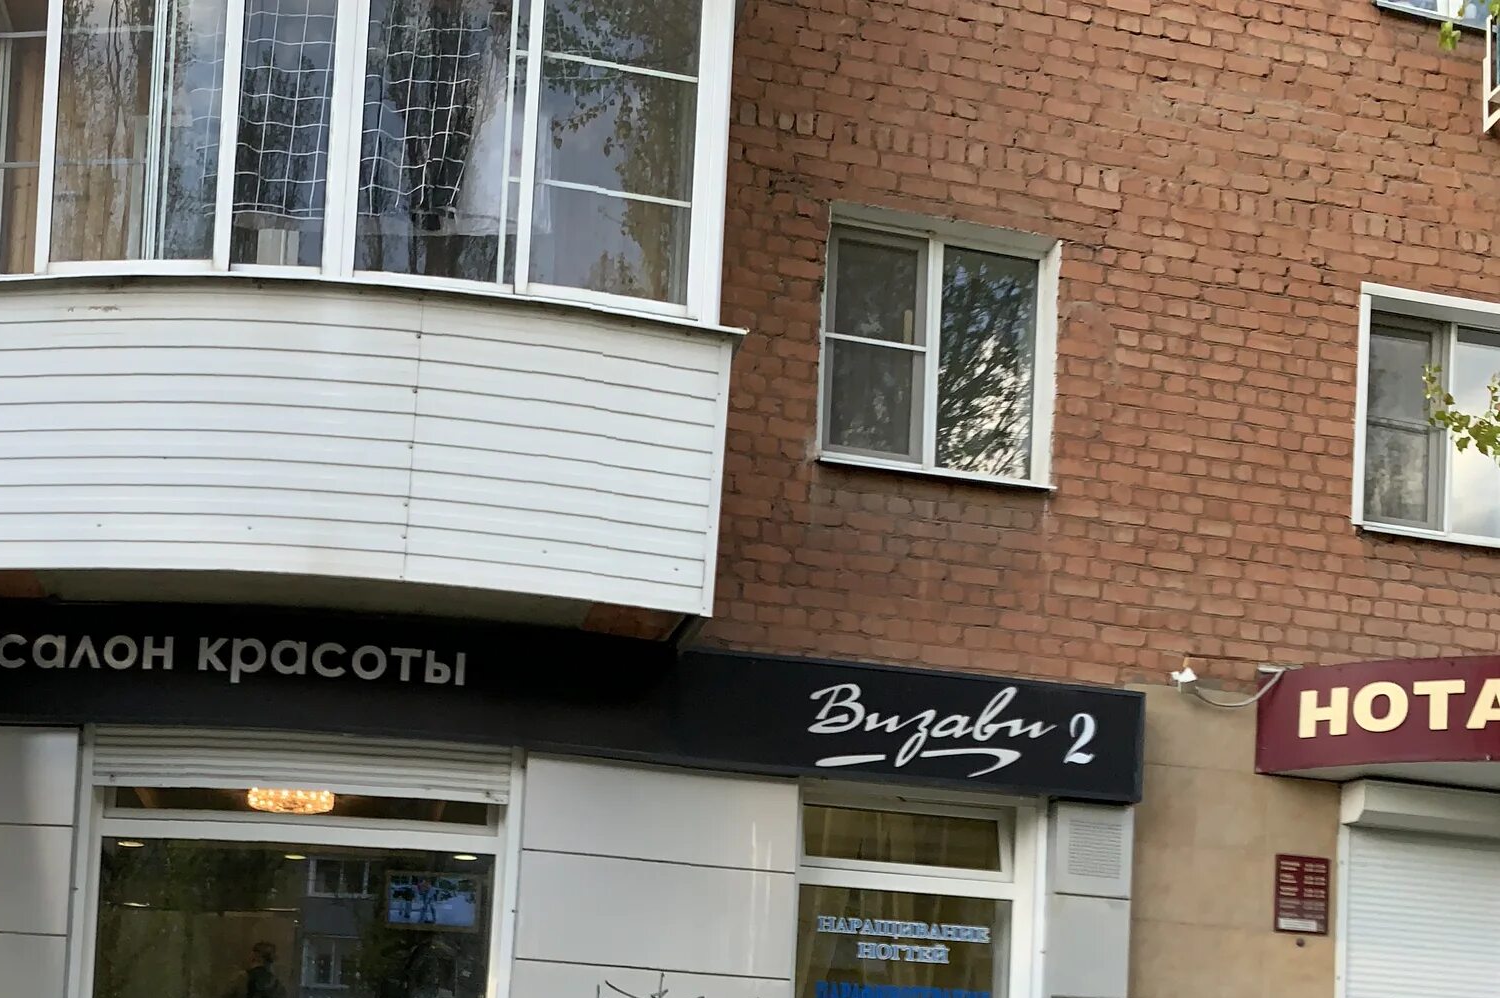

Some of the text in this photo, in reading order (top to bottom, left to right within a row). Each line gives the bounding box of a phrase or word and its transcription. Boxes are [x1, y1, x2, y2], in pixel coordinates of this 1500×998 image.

[197, 635, 467, 687] красоты
[806, 682, 1099, 770] Визави 2
[1297, 677, 1500, 740] НОТА
[816, 915, 992, 944] НАРАЩИВАНИЕ
[856, 941, 950, 964] НОГТЕЙ
